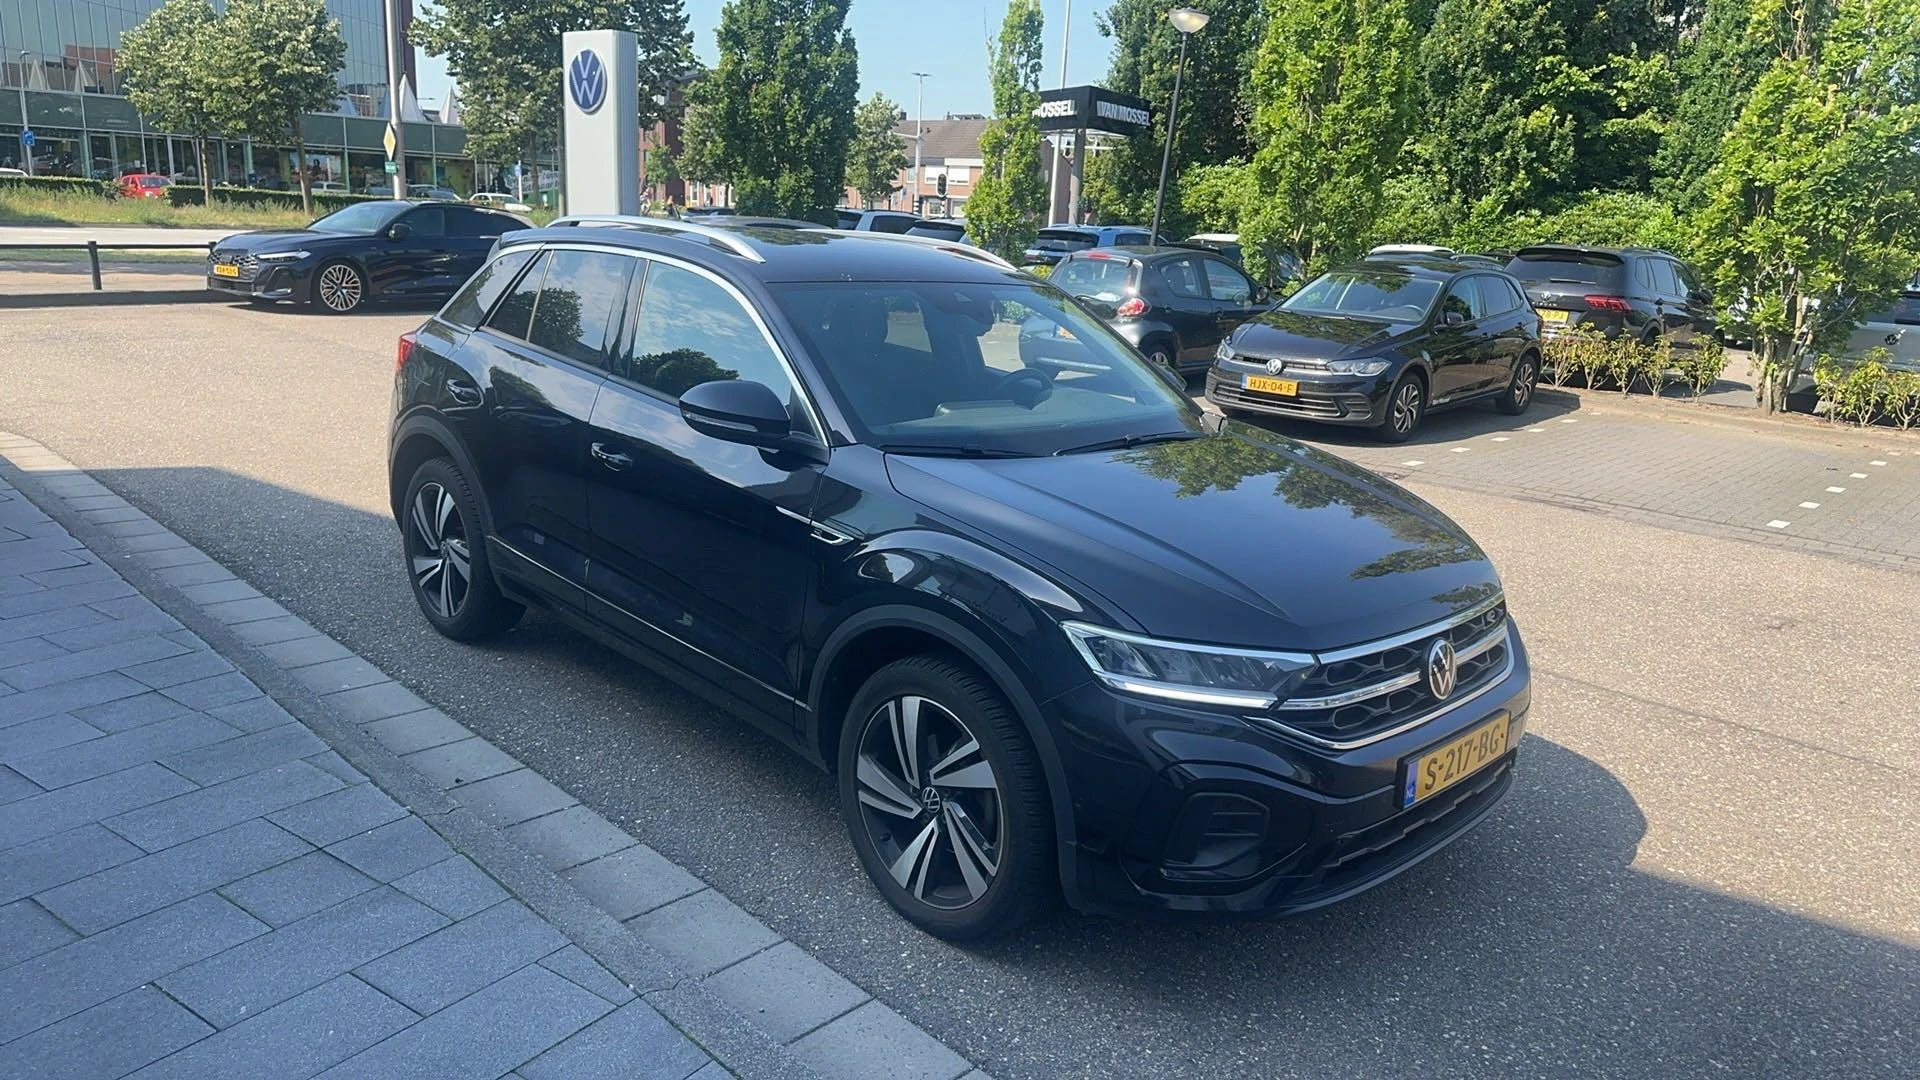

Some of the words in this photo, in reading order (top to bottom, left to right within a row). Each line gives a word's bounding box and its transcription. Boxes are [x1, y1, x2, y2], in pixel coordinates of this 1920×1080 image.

[1099, 101, 1118, 120] VAN
[1118, 105, 1150, 126] MOSSEL
[1249, 378, 1294, 393] HJX-04-F
[1424, 724, 1500, 790] S-217-BG
